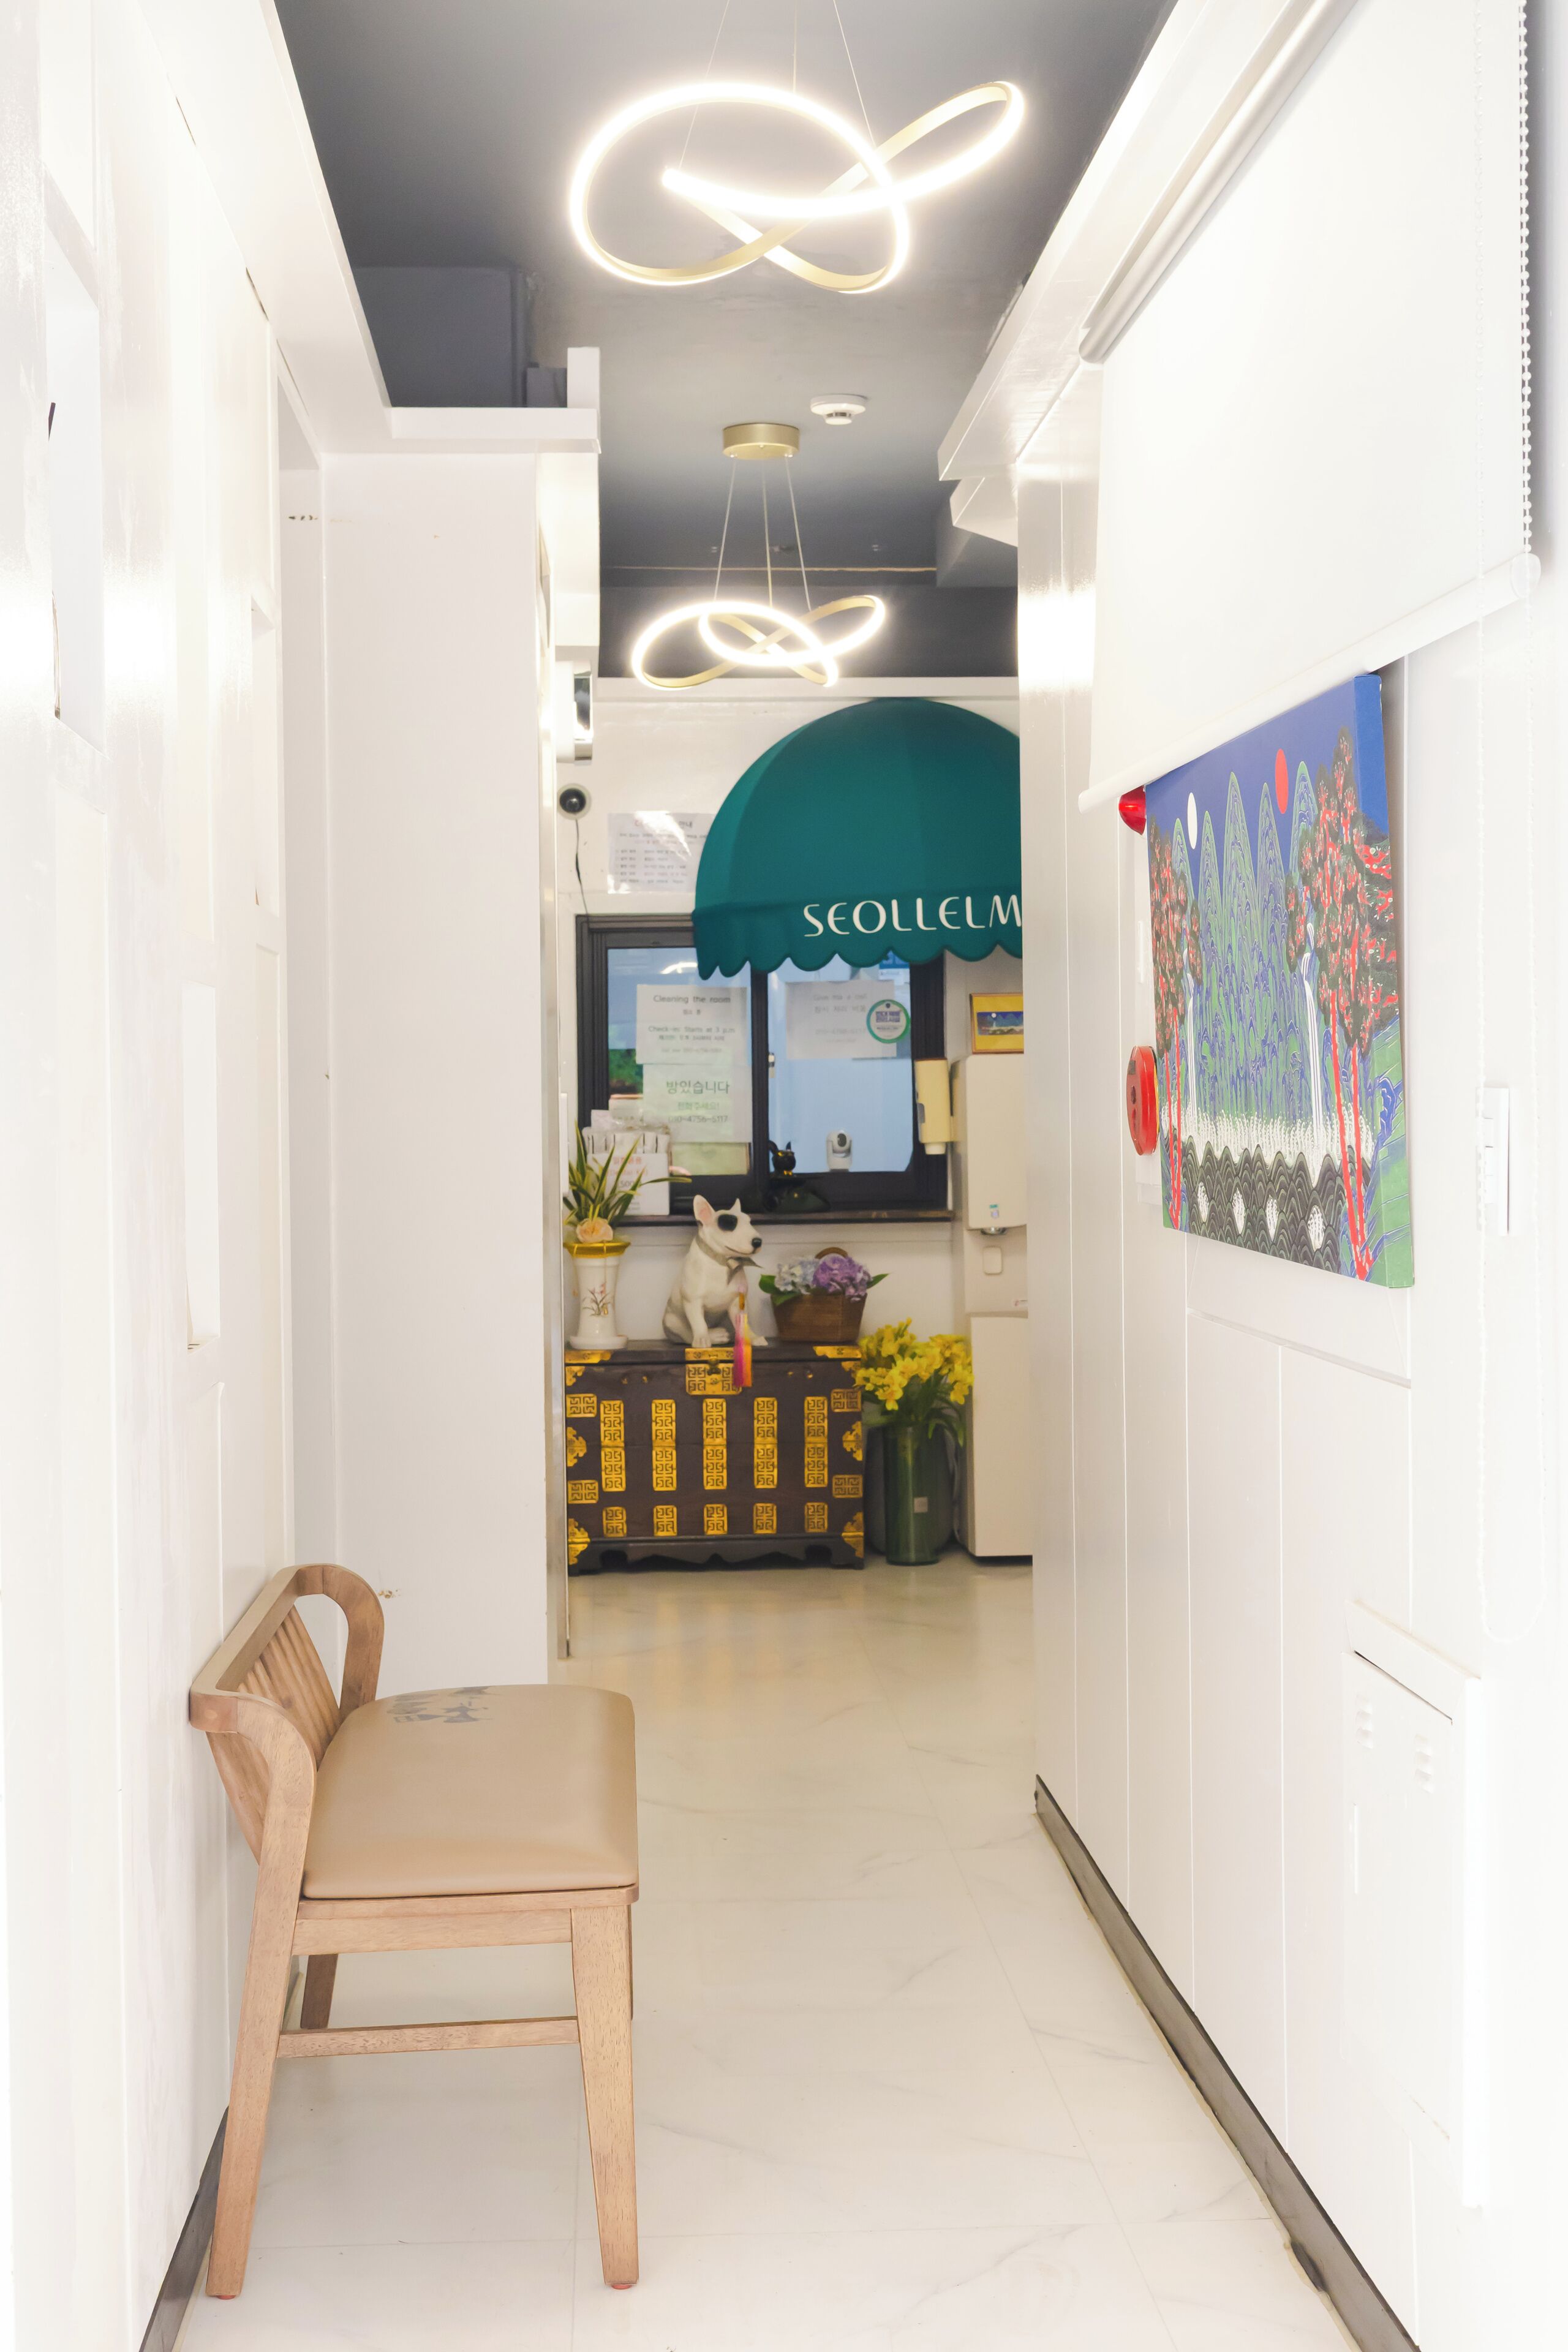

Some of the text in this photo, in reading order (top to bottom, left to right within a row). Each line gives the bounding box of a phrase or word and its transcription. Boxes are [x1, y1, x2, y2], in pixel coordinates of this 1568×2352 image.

[803, 894, 1022, 937] SEOLLELM
[653, 995, 689, 1004] Cleaning
[666, 1080, 730, 1095] 방있습니다
